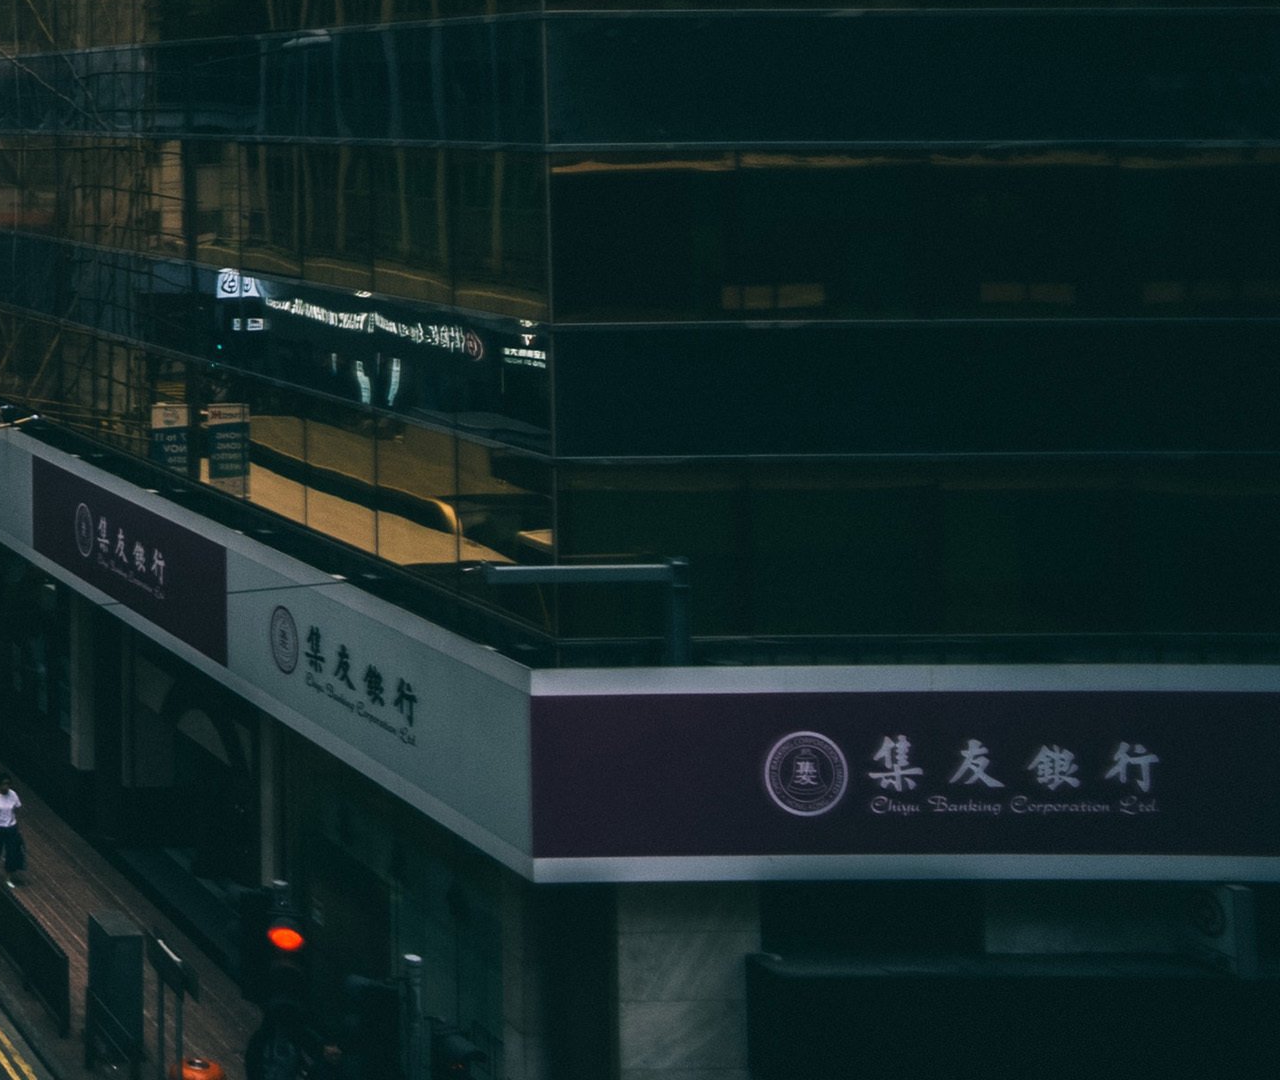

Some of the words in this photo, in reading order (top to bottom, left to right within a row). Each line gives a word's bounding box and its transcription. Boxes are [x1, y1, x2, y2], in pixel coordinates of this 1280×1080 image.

[305, 625, 418, 728] 集友銀行
[868, 734, 1160, 793] 集友銀行
[869, 795, 921, 817] Chiyu
[927, 794, 1002, 815] Banking
[1010, 794, 1110, 814] Corporation
[1119, 795, 1160, 816] Ltd.
